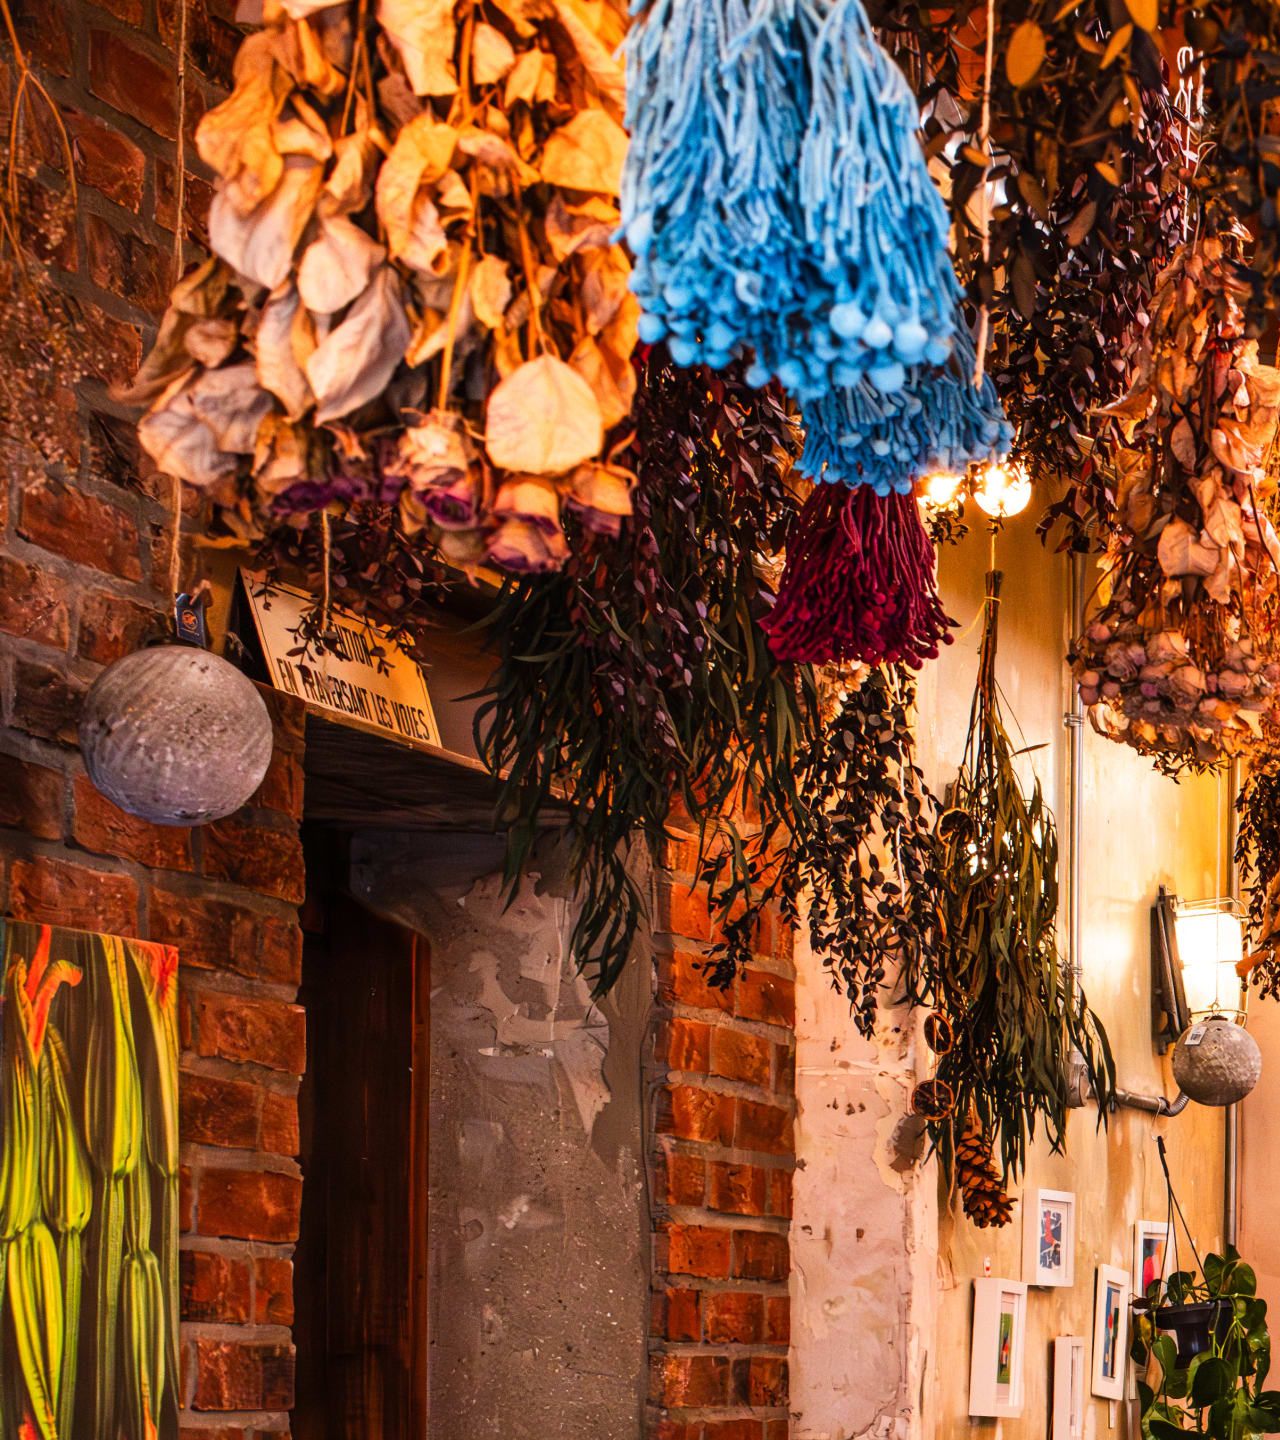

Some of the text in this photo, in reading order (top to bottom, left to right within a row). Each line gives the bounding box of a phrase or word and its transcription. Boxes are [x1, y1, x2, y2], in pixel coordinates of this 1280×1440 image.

[276, 657, 300, 696] EN
[370, 690, 394, 730] LES
[391, 703, 430, 741] VOIES
